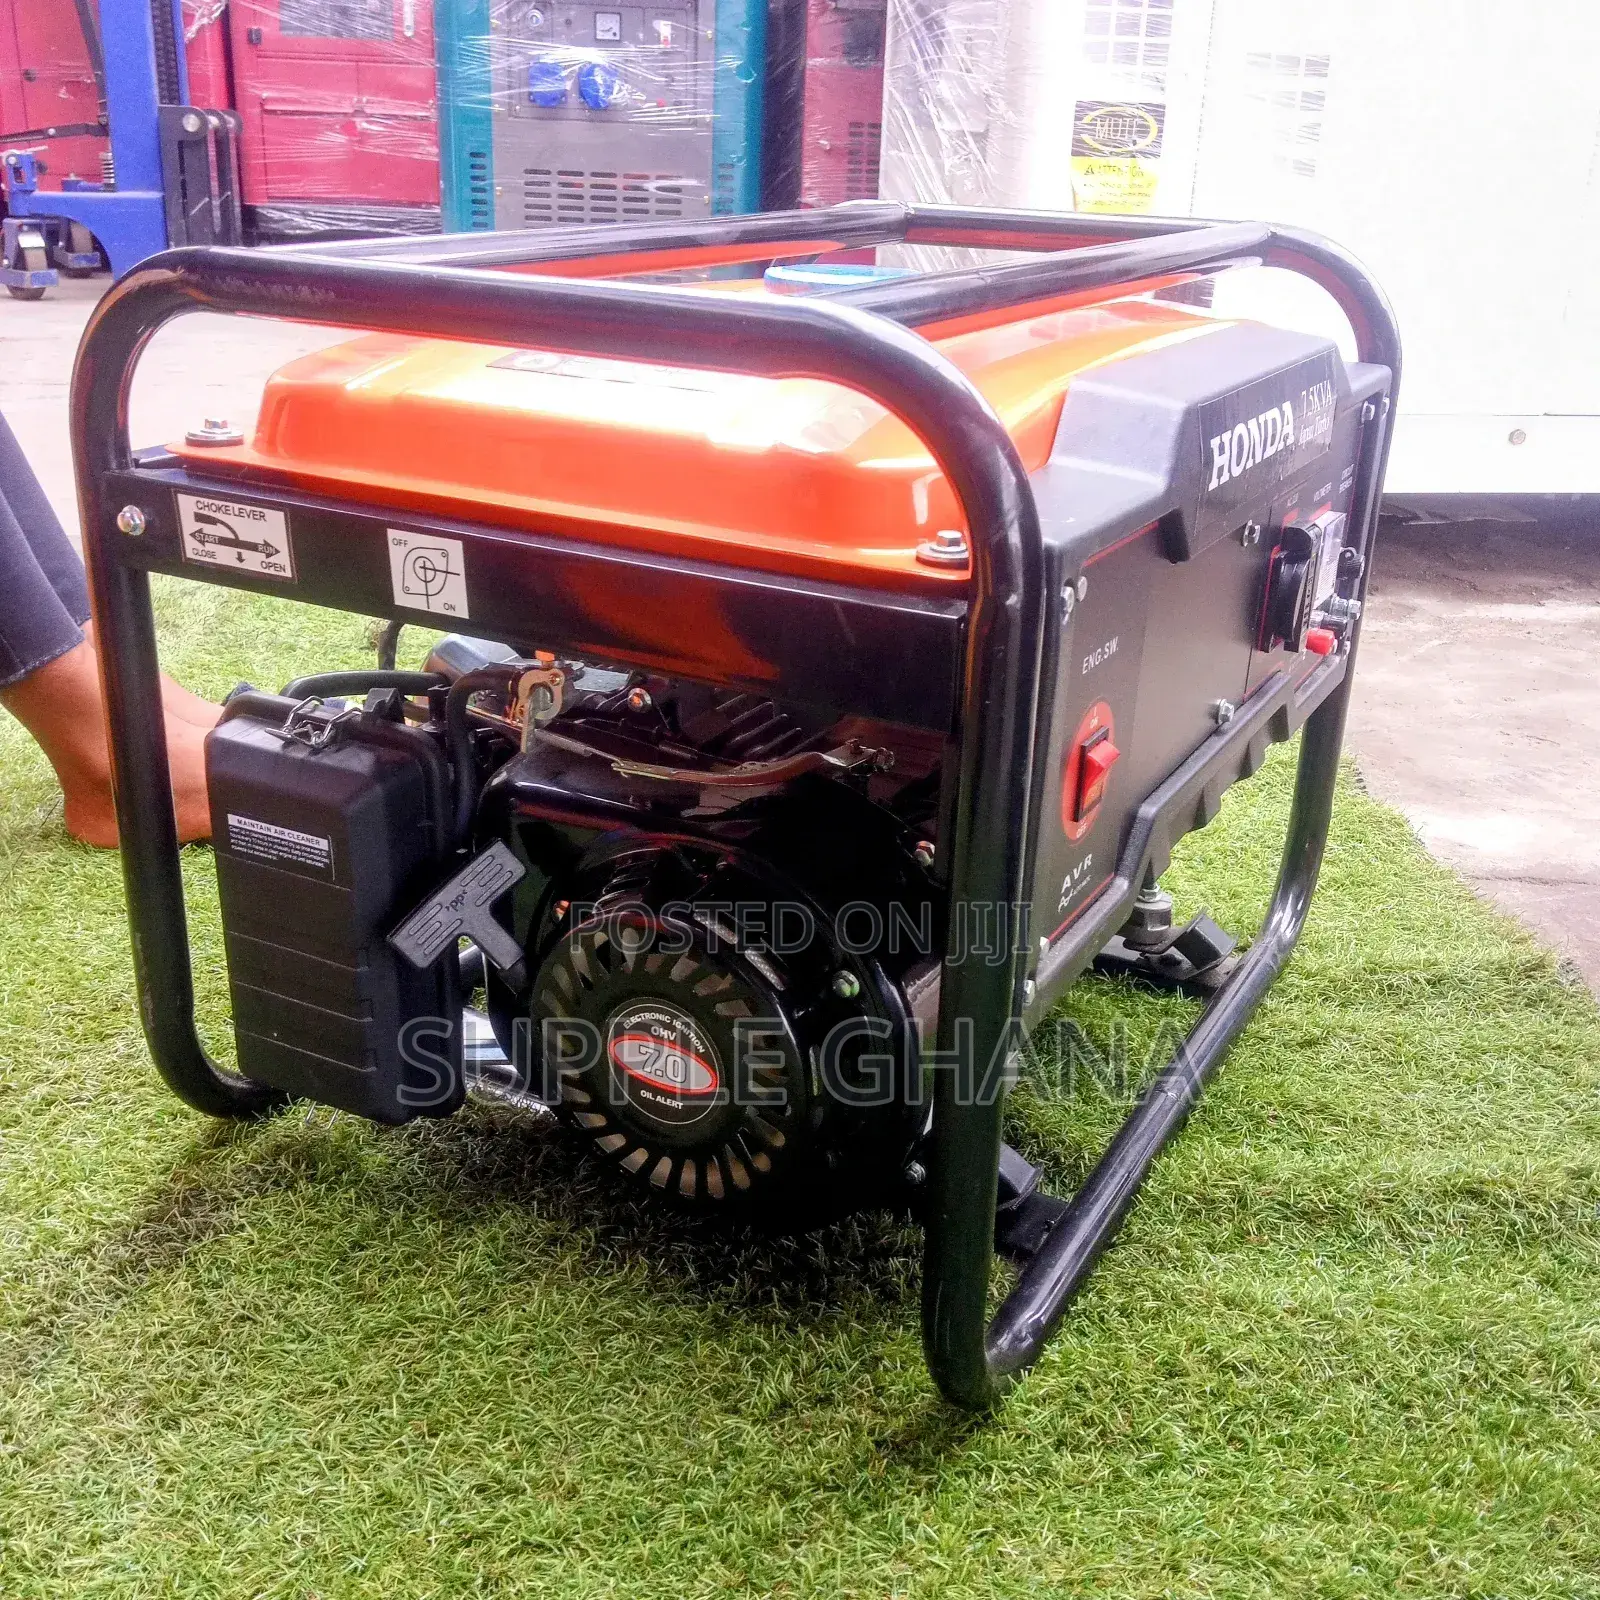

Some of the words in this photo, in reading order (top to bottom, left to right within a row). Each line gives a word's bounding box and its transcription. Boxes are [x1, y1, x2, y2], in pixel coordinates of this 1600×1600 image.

[1208, 401, 1294, 491] HONDA
[195, 500, 232, 516] CHOKE
[232, 505, 267, 521] LEVER
[195, 532, 220, 544] START
[392, 537, 408, 548] OFF
[192, 547, 217, 559] CLOSE
[257, 544, 276, 555] RUN
[260, 560, 286, 573] OPEN
[443, 602, 456, 612] ON
[1082, 636, 1119, 675] ENG.SW.
[236, 818, 272, 833] MAINTAIN
[274, 829, 286, 837] AIR
[287, 832, 320, 846] CLEANER
[1061, 853, 1093, 894] AVR
[623, 1012, 671, 1030] ELECTRONIC
[672, 1019, 706, 1054] IGNITION
[650, 1026, 677, 1040] OHV
[638, 1044, 688, 1084] 7.0
[640, 1089, 655, 1101] OIL
[655, 1095, 684, 1110] ALERT
